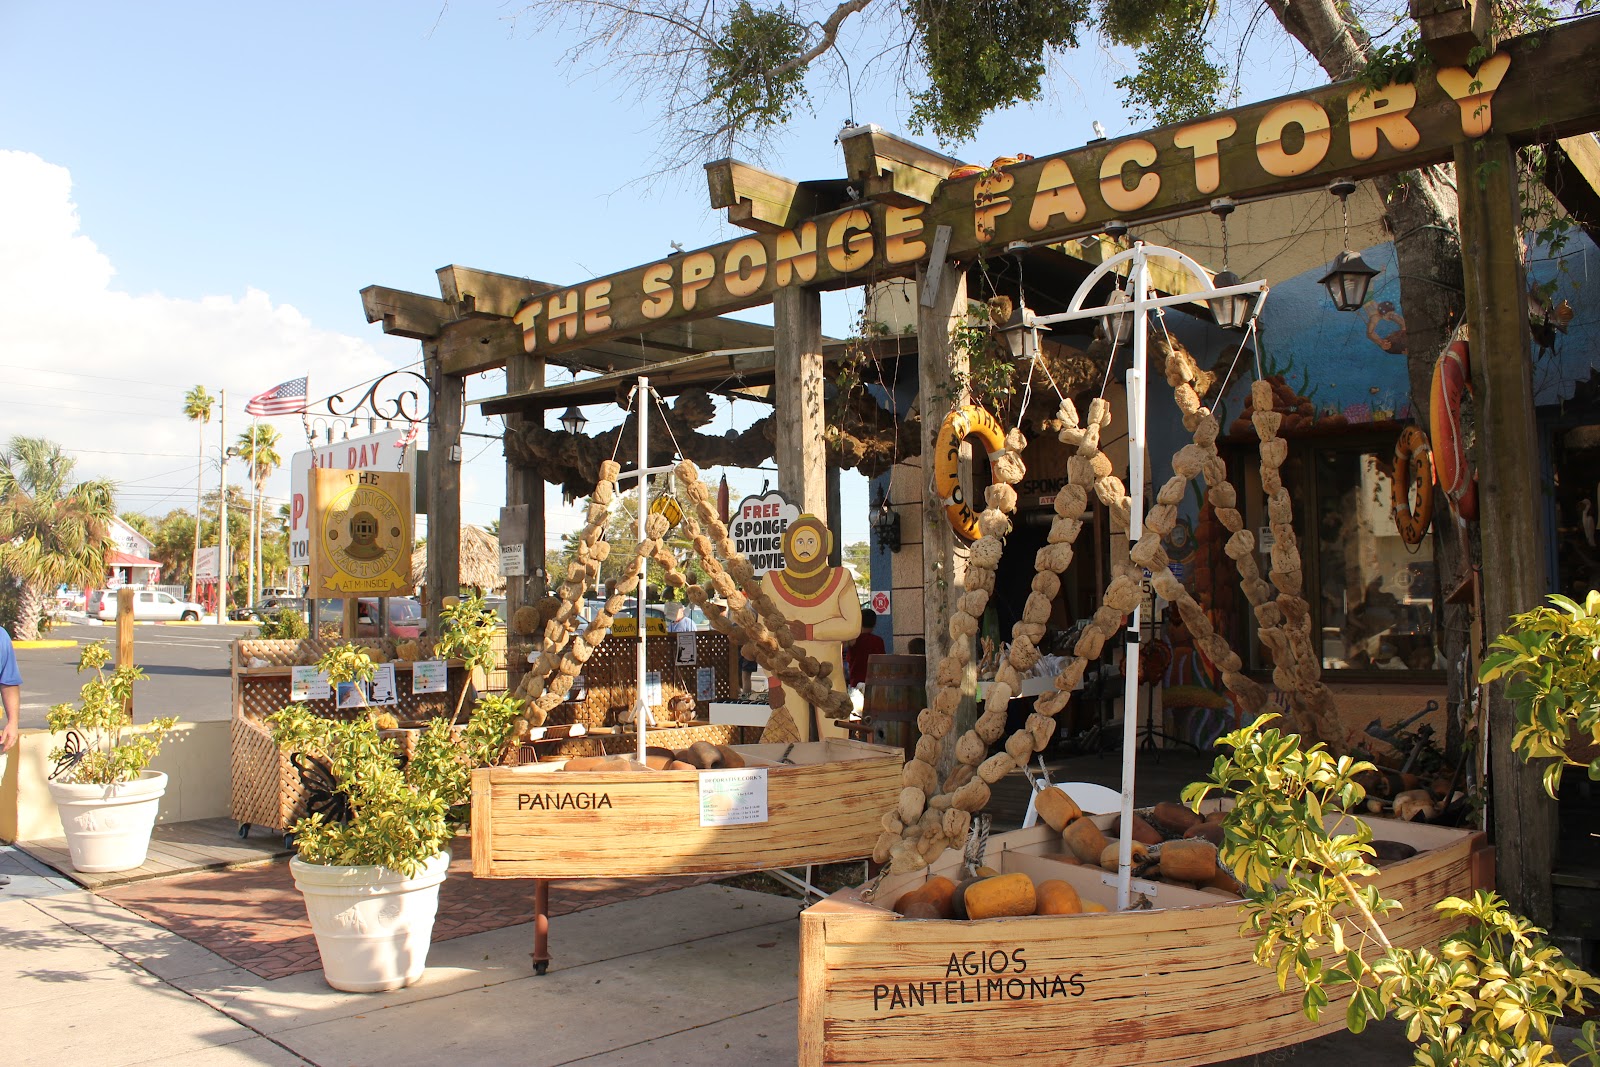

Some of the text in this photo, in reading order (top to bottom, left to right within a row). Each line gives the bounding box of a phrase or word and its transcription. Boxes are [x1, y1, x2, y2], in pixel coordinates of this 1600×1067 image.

[513, 52, 1512, 354] THE SPONGE FACTORY
[974, 405, 999, 436] THE
[348, 442, 380, 470] DAY
[345, 472, 380, 486] THE
[1023, 477, 1067, 495] SPONG
[331, 490, 397, 525] SPONGE
[743, 503, 780, 520] FREE
[734, 518, 788, 537] SPONGE
[736, 536, 782, 553] DIVING
[332, 541, 399, 577] FACTORY
[748, 552, 785, 570] MOVIE
[518, 792, 613, 810] PANAGIA
[945, 947, 1027, 978] AGIOS
[873, 973, 1085, 1011] PANTELIMONAS
